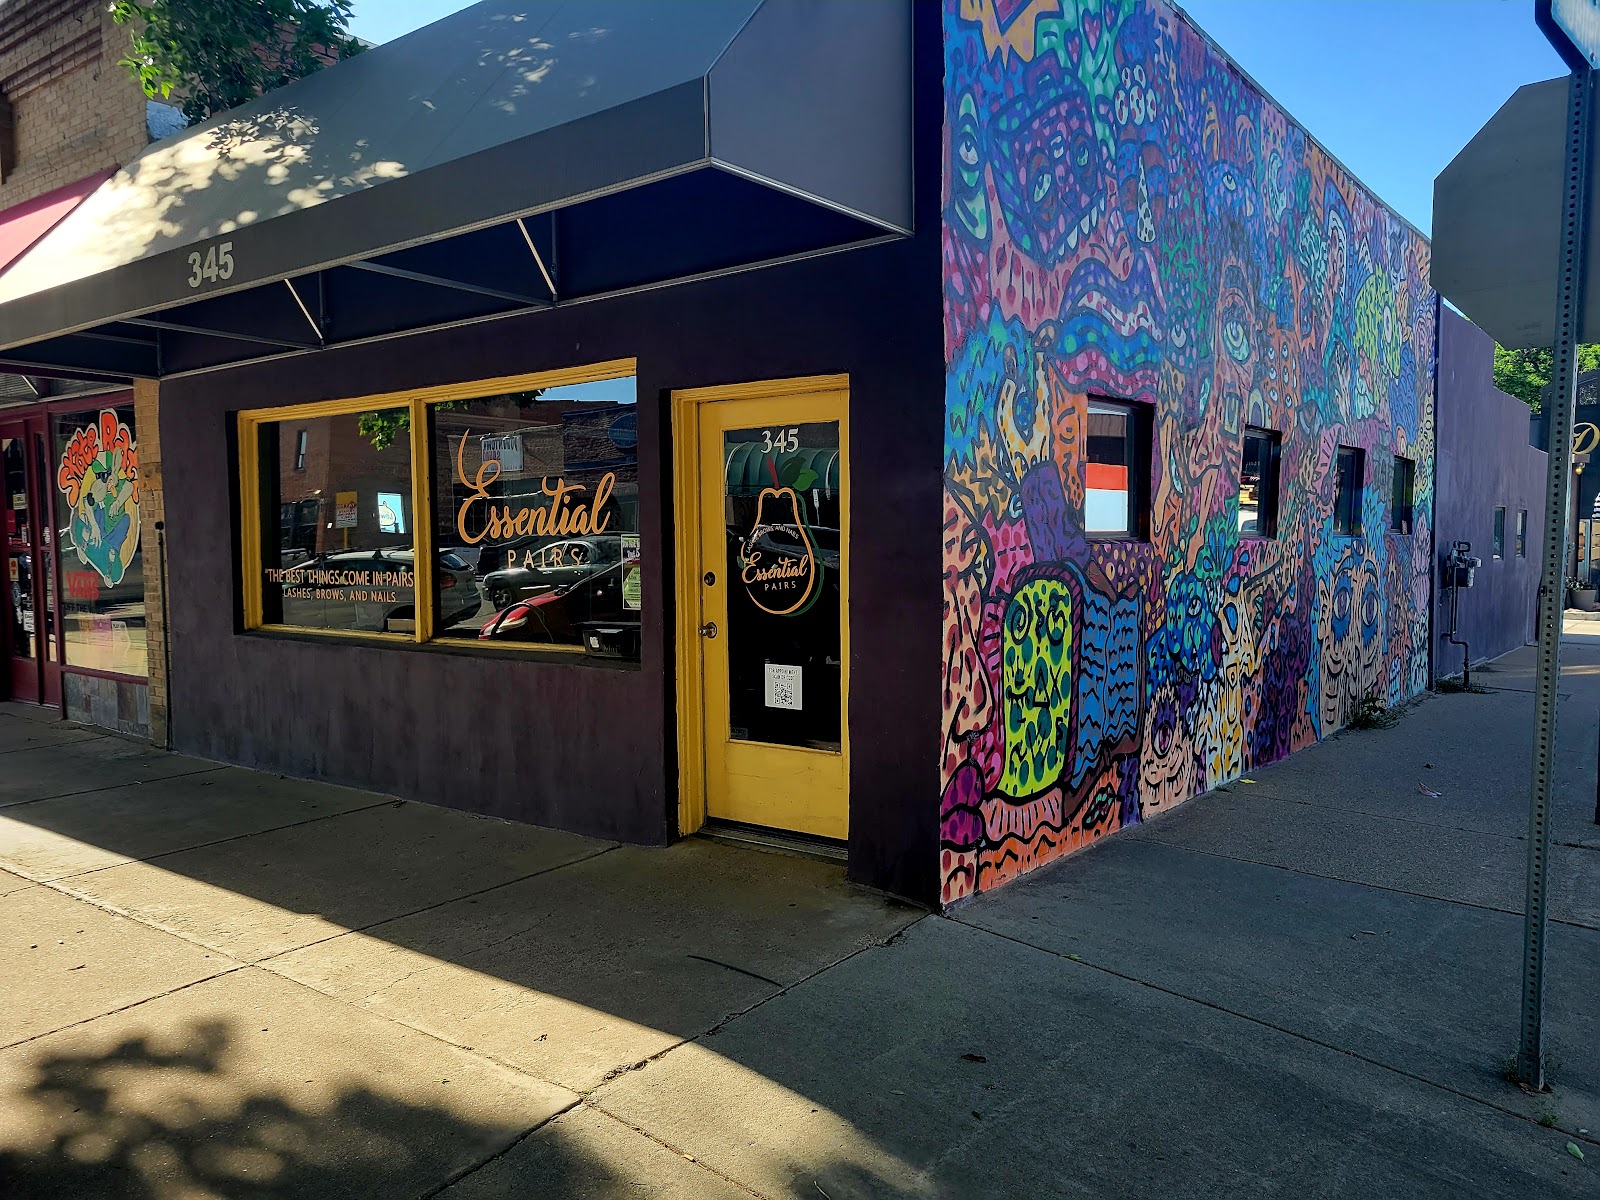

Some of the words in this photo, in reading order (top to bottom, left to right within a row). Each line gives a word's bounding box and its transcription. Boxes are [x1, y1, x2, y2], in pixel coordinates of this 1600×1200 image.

[188, 241, 234, 288] 345
[760, 427, 799, 454] 345
[457, 428, 615, 544] Essential
[507, 548, 583, 569] PAIRS
[741, 541, 809, 584] Essential
[286, 569, 306, 584] BEST
[307, 569, 340, 585] THINGS
[342, 570, 371, 586] COME
[372, 571, 383, 587] IN
[764, 580, 797, 592] PAIRS
[349, 590, 368, 601] AND
